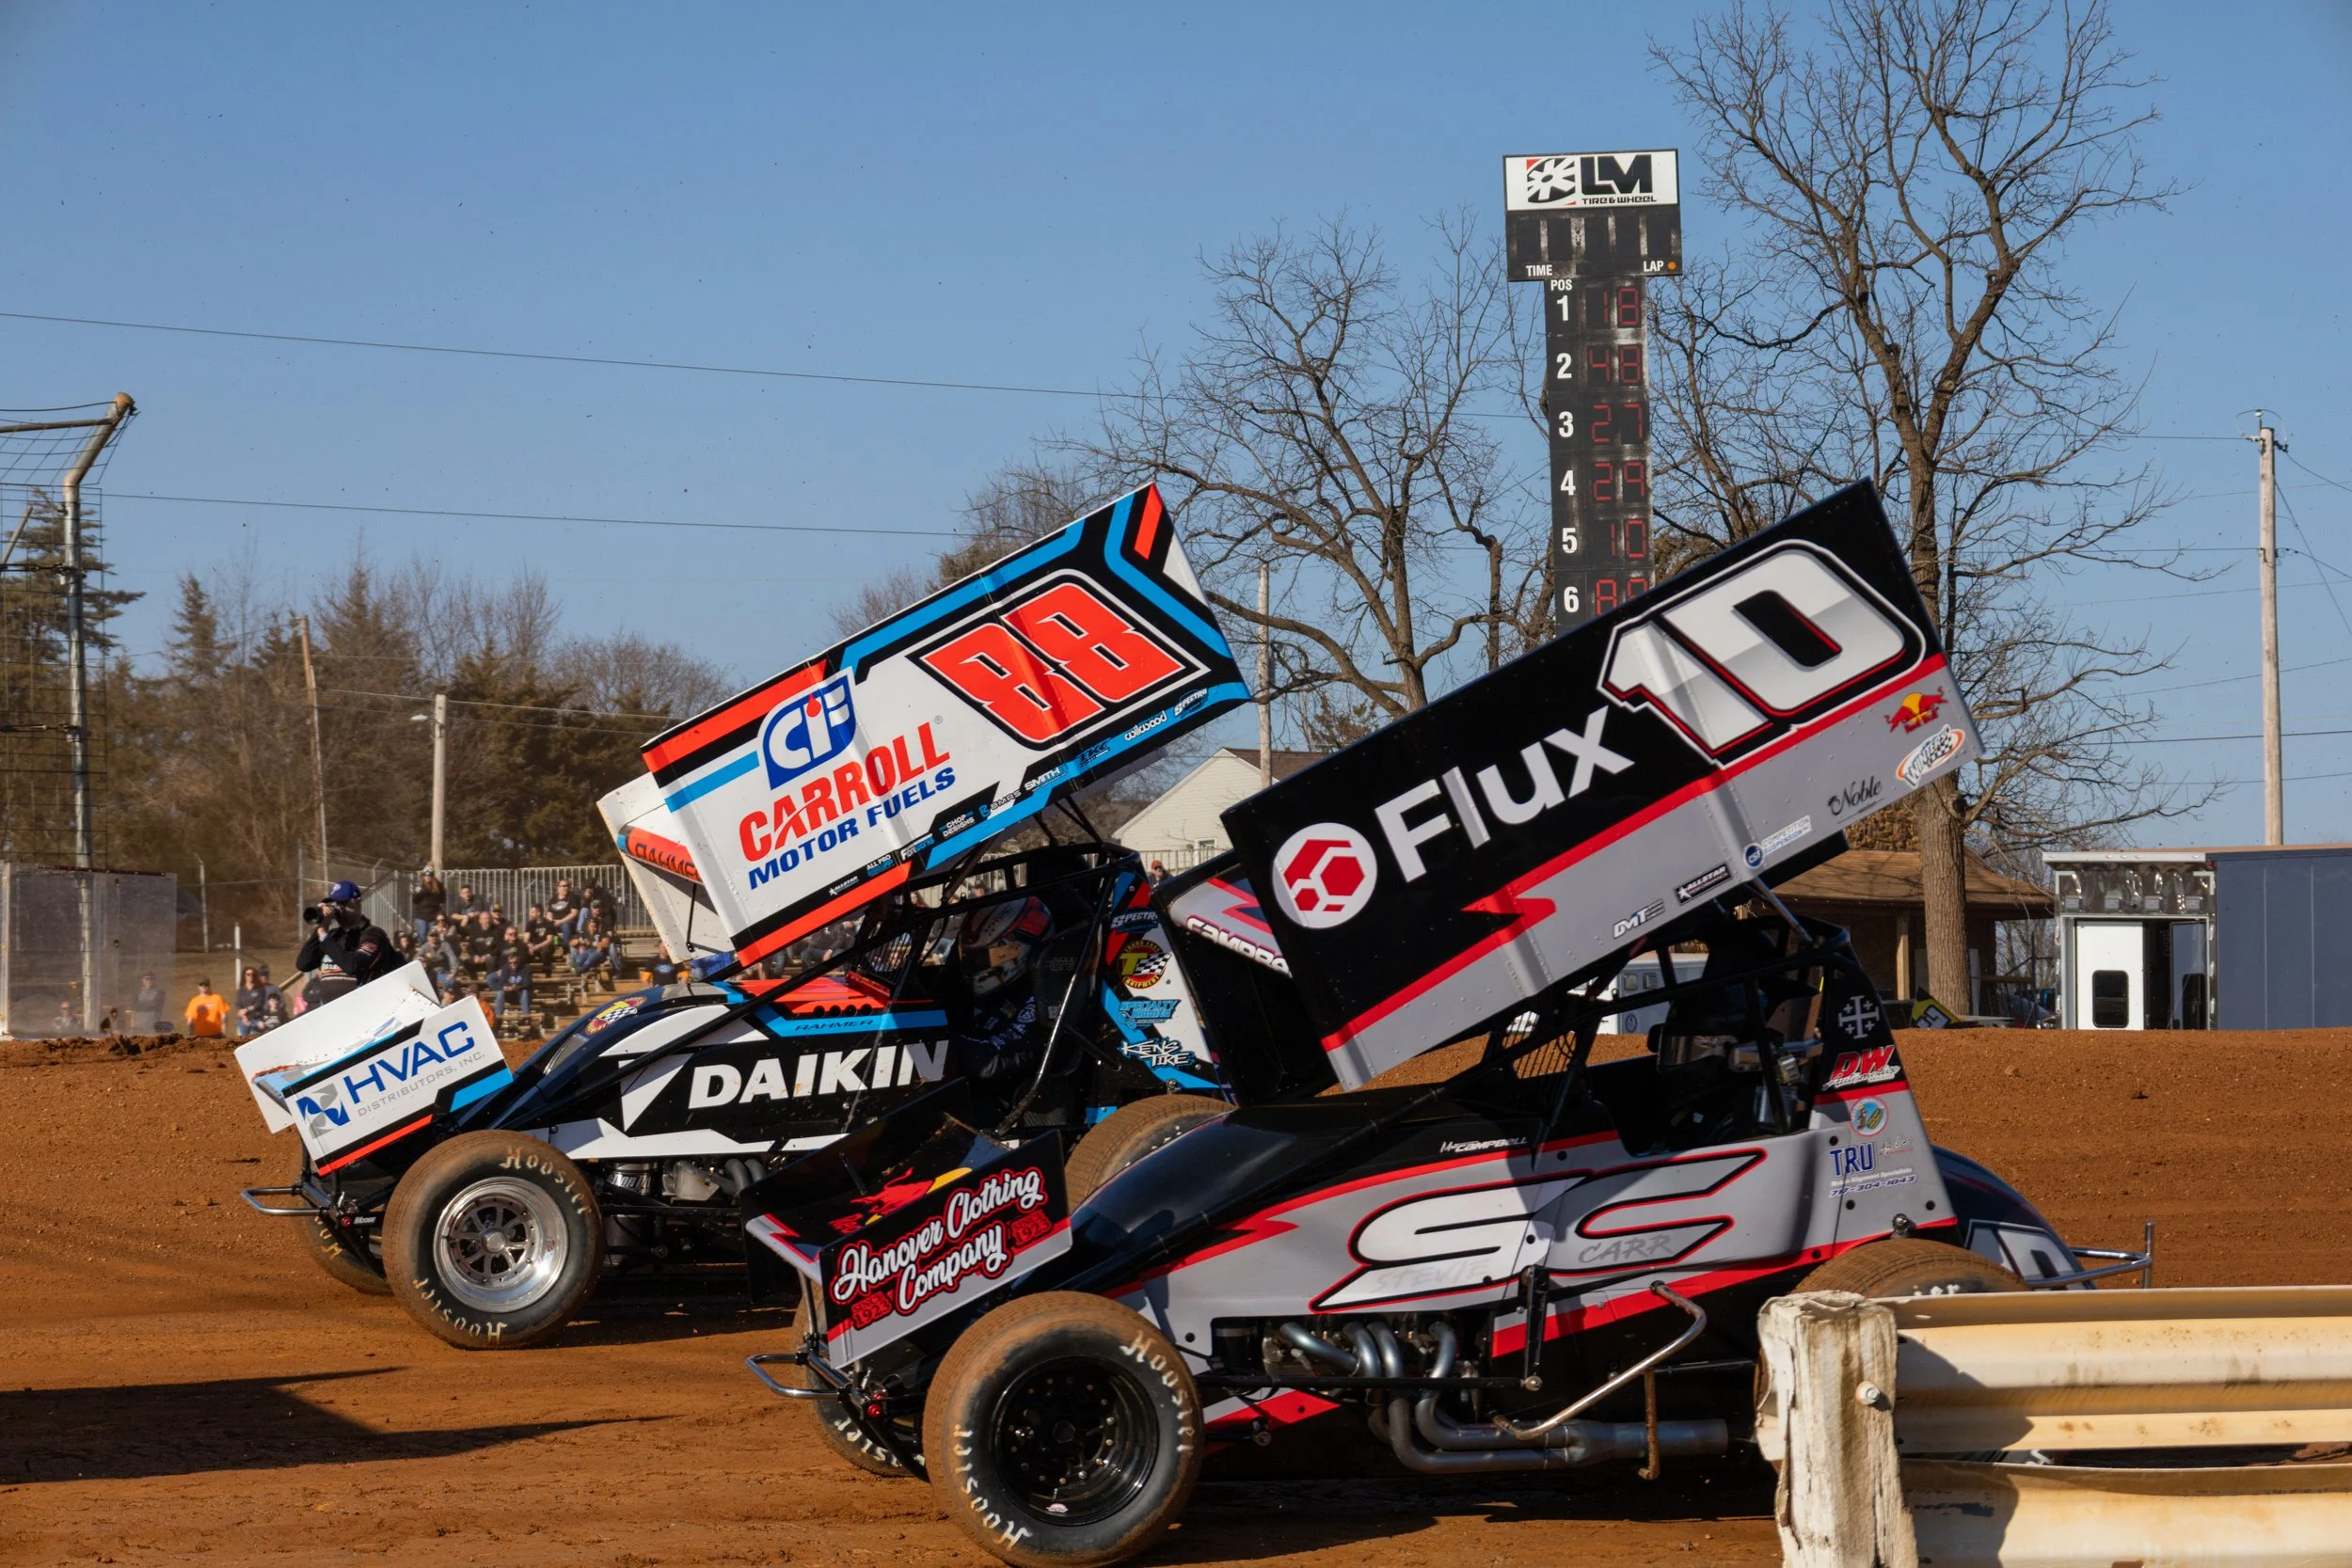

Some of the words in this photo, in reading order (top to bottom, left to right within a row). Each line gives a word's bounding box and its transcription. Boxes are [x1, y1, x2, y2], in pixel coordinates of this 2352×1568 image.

[1581, 154, 1652, 195] LM
[1526, 264, 1552, 277] TIME
[1644, 261, 1664, 272] LAP
[1550, 279, 1572, 291] POS
[1557, 294, 1569, 321] 1
[1603, 288, 1639, 325] 18
[1556, 353, 1572, 378] 2
[1589, 345, 1641, 384] 48
[1559, 411, 1574, 437] 3
[1592, 404, 1643, 444] 27
[1561, 469, 1576, 496] 4
[1593, 462, 1645, 500] 29
[1562, 528, 1578, 553] 5
[1611, 519, 1646, 558] 10
[1564, 586, 1579, 612] 6
[920, 582, 1186, 744] 88
[1601, 543, 1912, 755] 10
[739, 721, 951, 863] CARROLL
[1375, 705, 1635, 882] Flux
[748, 817, 858, 890] MOTOR
[867, 768, 956, 828] FUELS
[943, 816, 975, 837] DESIGNS
[946, 814, 966, 829] CHOP
[866, 861, 879, 871] ALL
[878, 854, 891, 864] PRO
[343, 1022, 475, 1103] HVAC
[688, 1039, 949, 1109] DAIKIN
[1829, 1045, 1895, 1081] DW
[358, 1065, 457, 1117] DISTRIBUTORS,
[460, 1053, 485, 1071] INC.
[1829, 1142, 1875, 1177] TRU
[833, 1219, 943, 1301] Hanover
[946, 1171, 1043, 1239] Clothing
[1578, 1234, 1672, 1266] CARR
[898, 1224, 1007, 1310] Company
[1375, 1258, 1490, 1293] STEVIE
[854, 1301, 892, 1326] 1923
